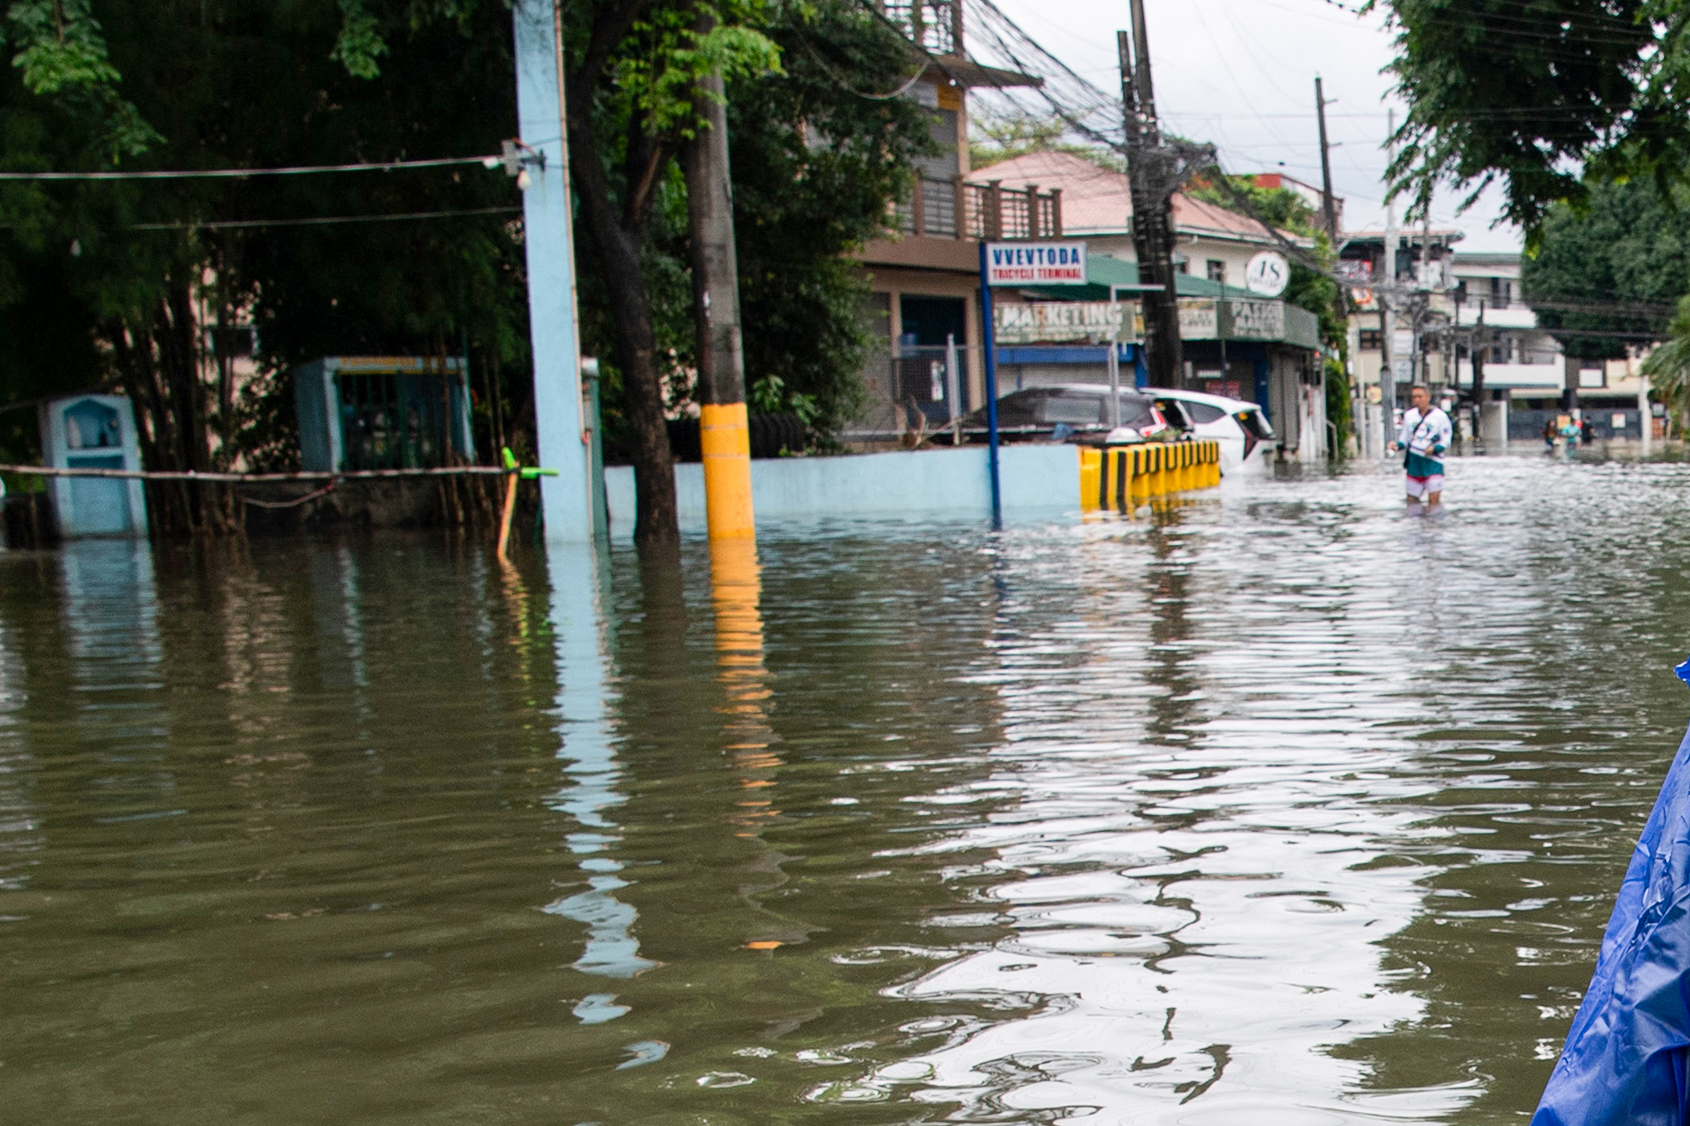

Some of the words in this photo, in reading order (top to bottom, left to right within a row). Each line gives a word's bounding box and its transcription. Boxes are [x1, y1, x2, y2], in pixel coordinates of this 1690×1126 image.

[993, 248, 1080, 265] VVEVTODA
[993, 268, 1034, 279] TRICYCLE
[1038, 268, 1082, 279] TERMINAL
